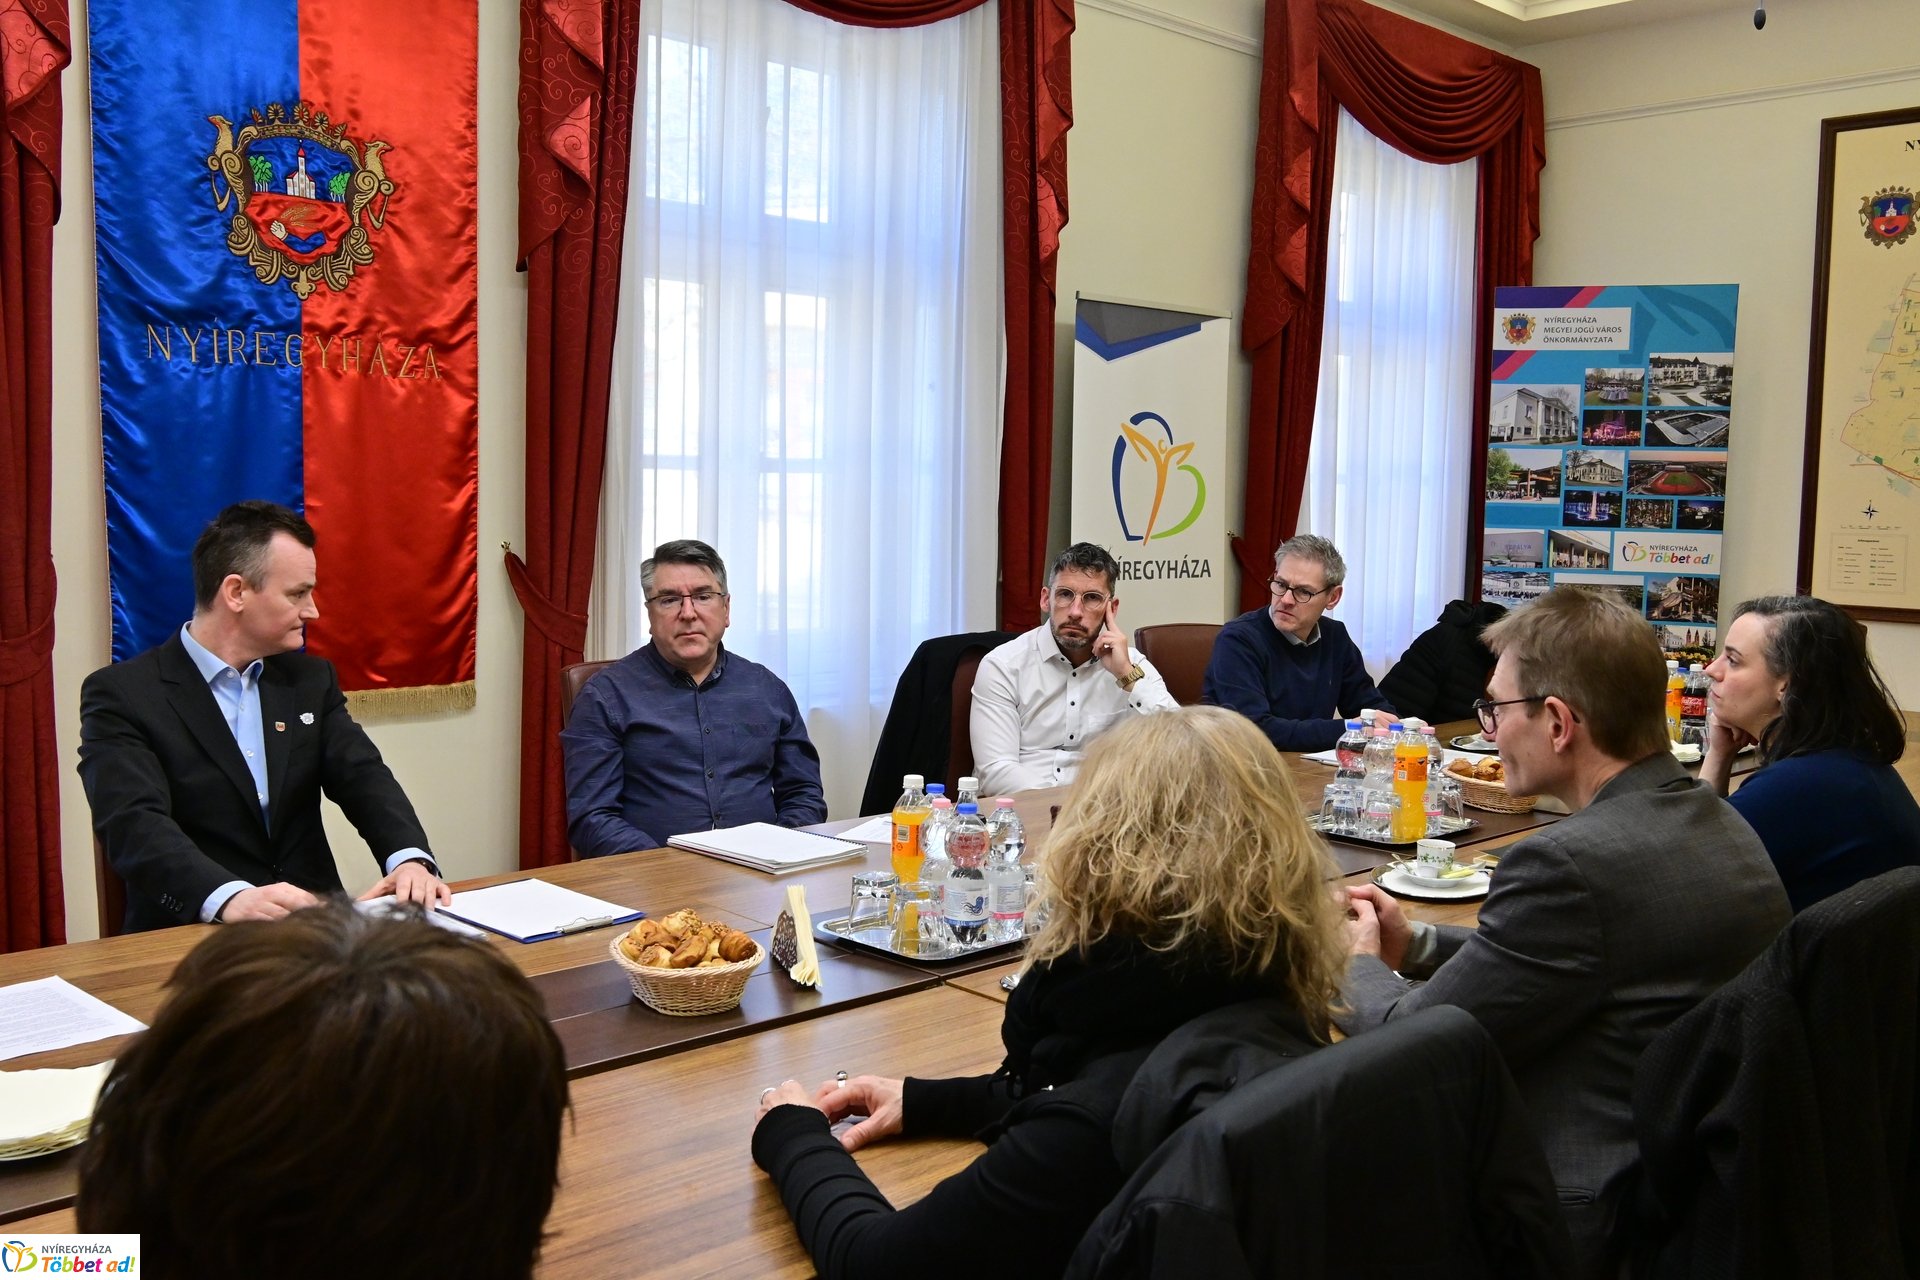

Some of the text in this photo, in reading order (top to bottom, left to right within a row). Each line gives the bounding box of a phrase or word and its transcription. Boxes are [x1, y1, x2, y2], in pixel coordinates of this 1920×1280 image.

[1905, 139, 1920, 151] N
[1544, 316, 1597, 324] NYÍREGYHÁZA
[1573, 326, 1595, 334] JOGÚ
[1596, 326, 1622, 334] VÁROS
[1543, 335, 1613, 343] ÖNKORMÁNYZATA
[147, 316, 441, 379] NYÍREGYHÁZA
[1649, 544, 1698, 552] NYÍREGYHÁZA
[1649, 552, 1714, 565] Többet ad!
[1117, 554, 1211, 580] ÍREGYHÁZA
